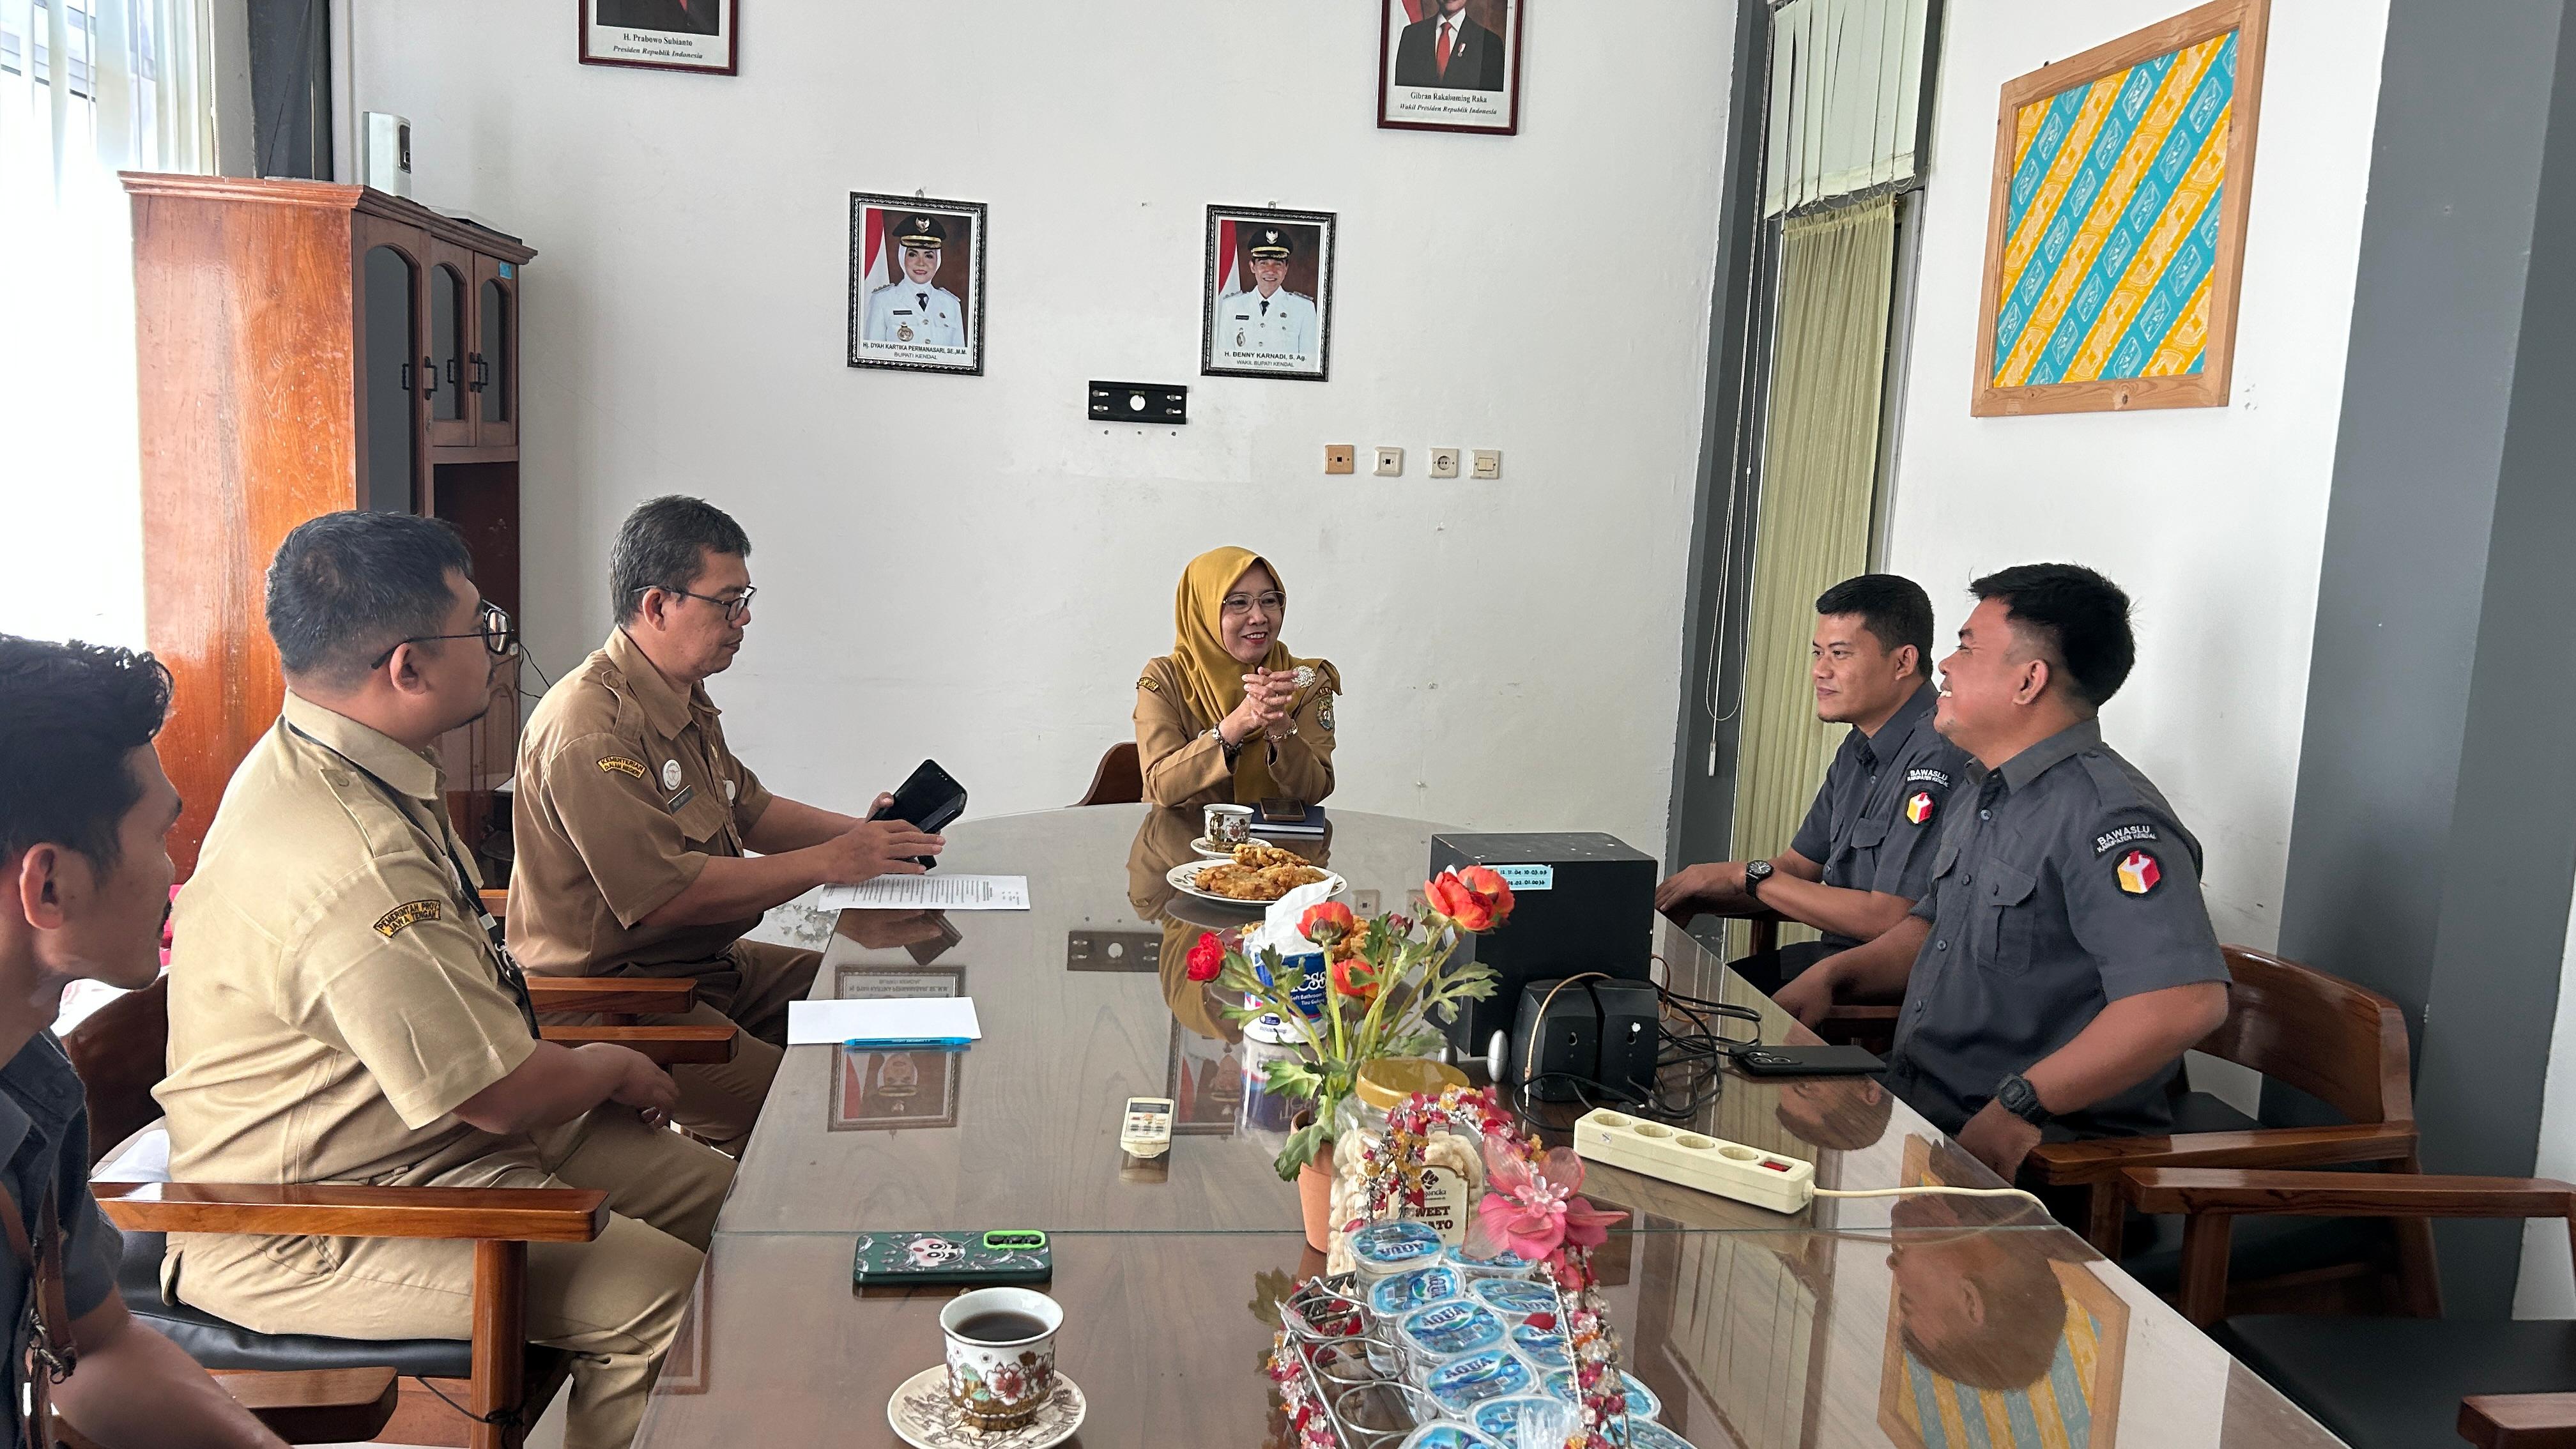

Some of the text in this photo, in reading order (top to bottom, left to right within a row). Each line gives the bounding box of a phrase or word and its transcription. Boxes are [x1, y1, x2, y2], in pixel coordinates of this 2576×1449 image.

[633, 34, 662, 44] Prabowo
[664, 36, 693, 47] Subianto
[613, 45, 703, 59] Presiden Republik Indonesia
[1410, 91, 1432, 100] Gibran
[1433, 93, 1471, 103] Rakabuming
[1910, 769, 1948, 781] BAWASLU
[2097, 825, 2150, 845] BAWASLU
[377, 903, 420, 931] PEMERINTAH
[390, 909, 436, 933] JAWA TENGAH
[1377, 1243, 1425, 1257] AQUA
[1421, 1305, 1468, 1326] AQUA
[1445, 1357, 1496, 1379] AQUA
